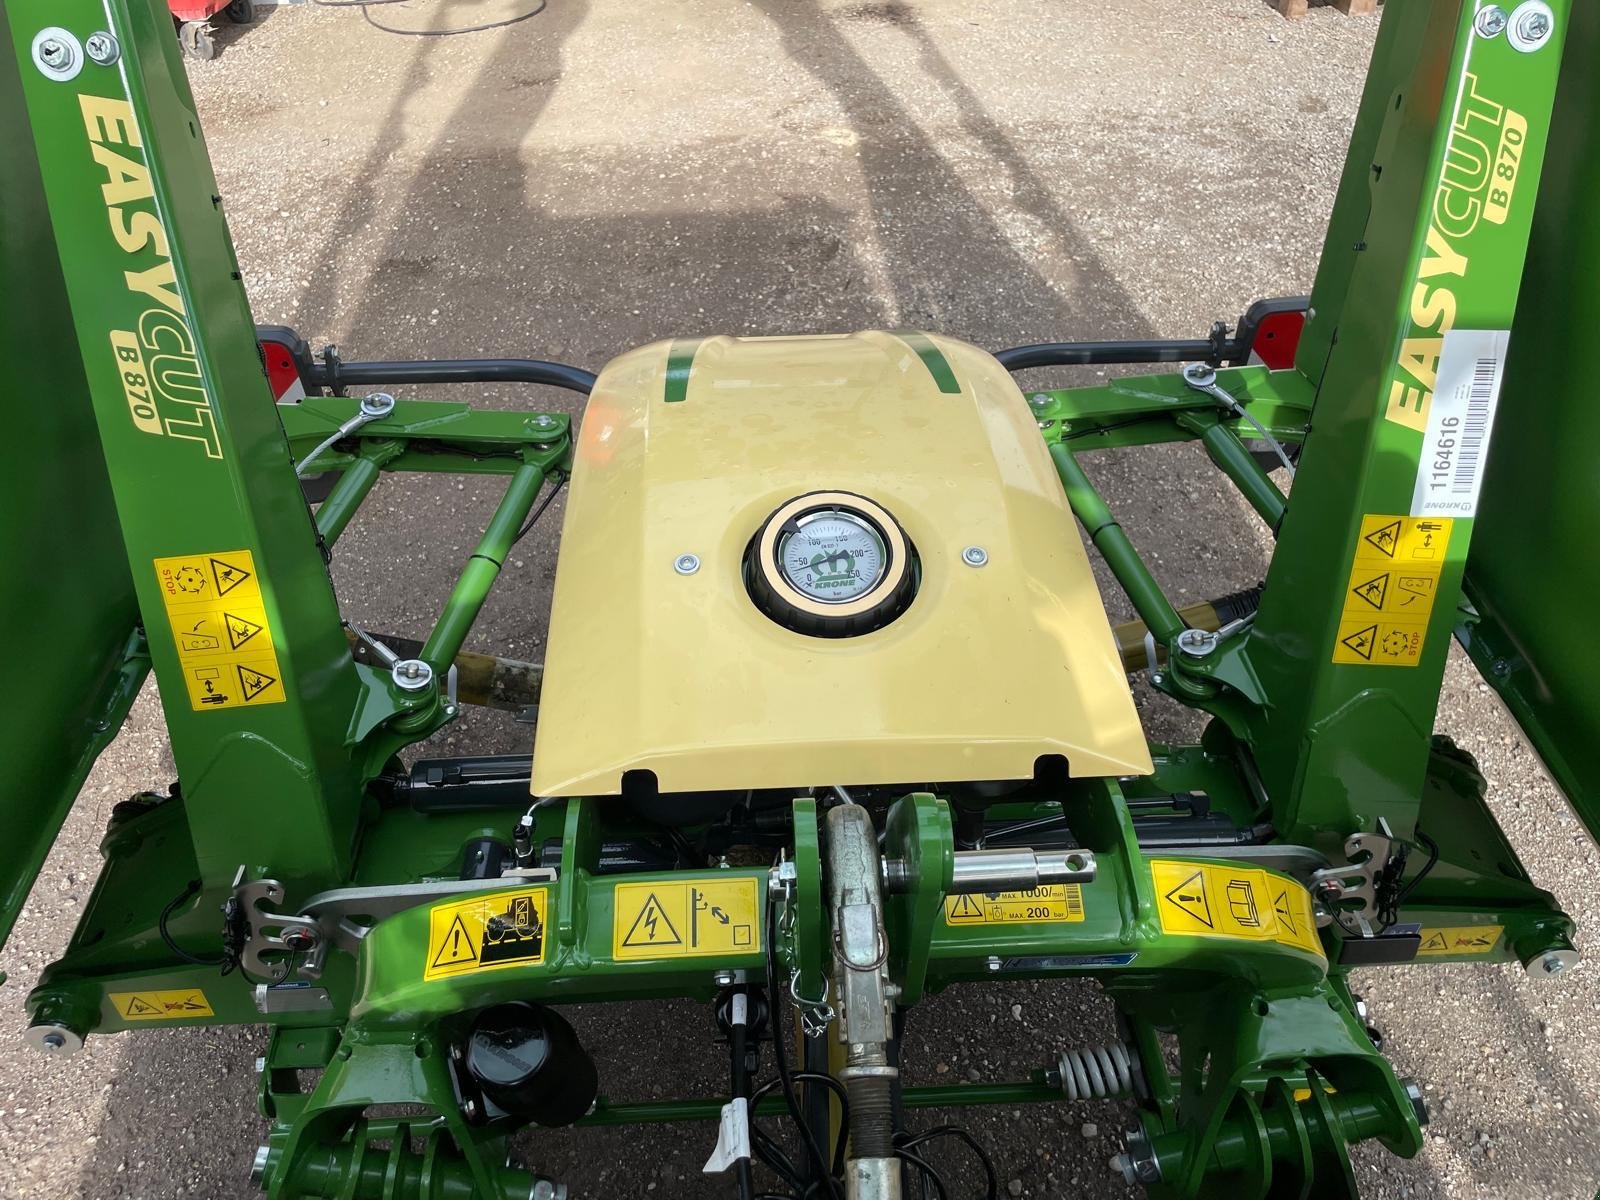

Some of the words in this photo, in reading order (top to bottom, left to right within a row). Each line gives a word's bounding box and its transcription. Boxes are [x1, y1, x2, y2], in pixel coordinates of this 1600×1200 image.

[1496, 127, 1523, 181] 870
[1490, 189, 1509, 209] B
[78, 93, 223, 459] EASYCUT
[115, 347, 138, 361] B
[122, 371, 154, 421] 870
[1430, 416, 1459, 490] 1164616
[799, 557, 808, 565] 50
[850, 549, 864, 558] 200
[162, 569, 176, 595] STOP
[807, 574, 812, 582] 0
[848, 570, 860, 578] 250
[815, 580, 855, 589] KRONE
[1408, 632, 1421, 656] STOP
[1026, 907, 1049, 918] 200
